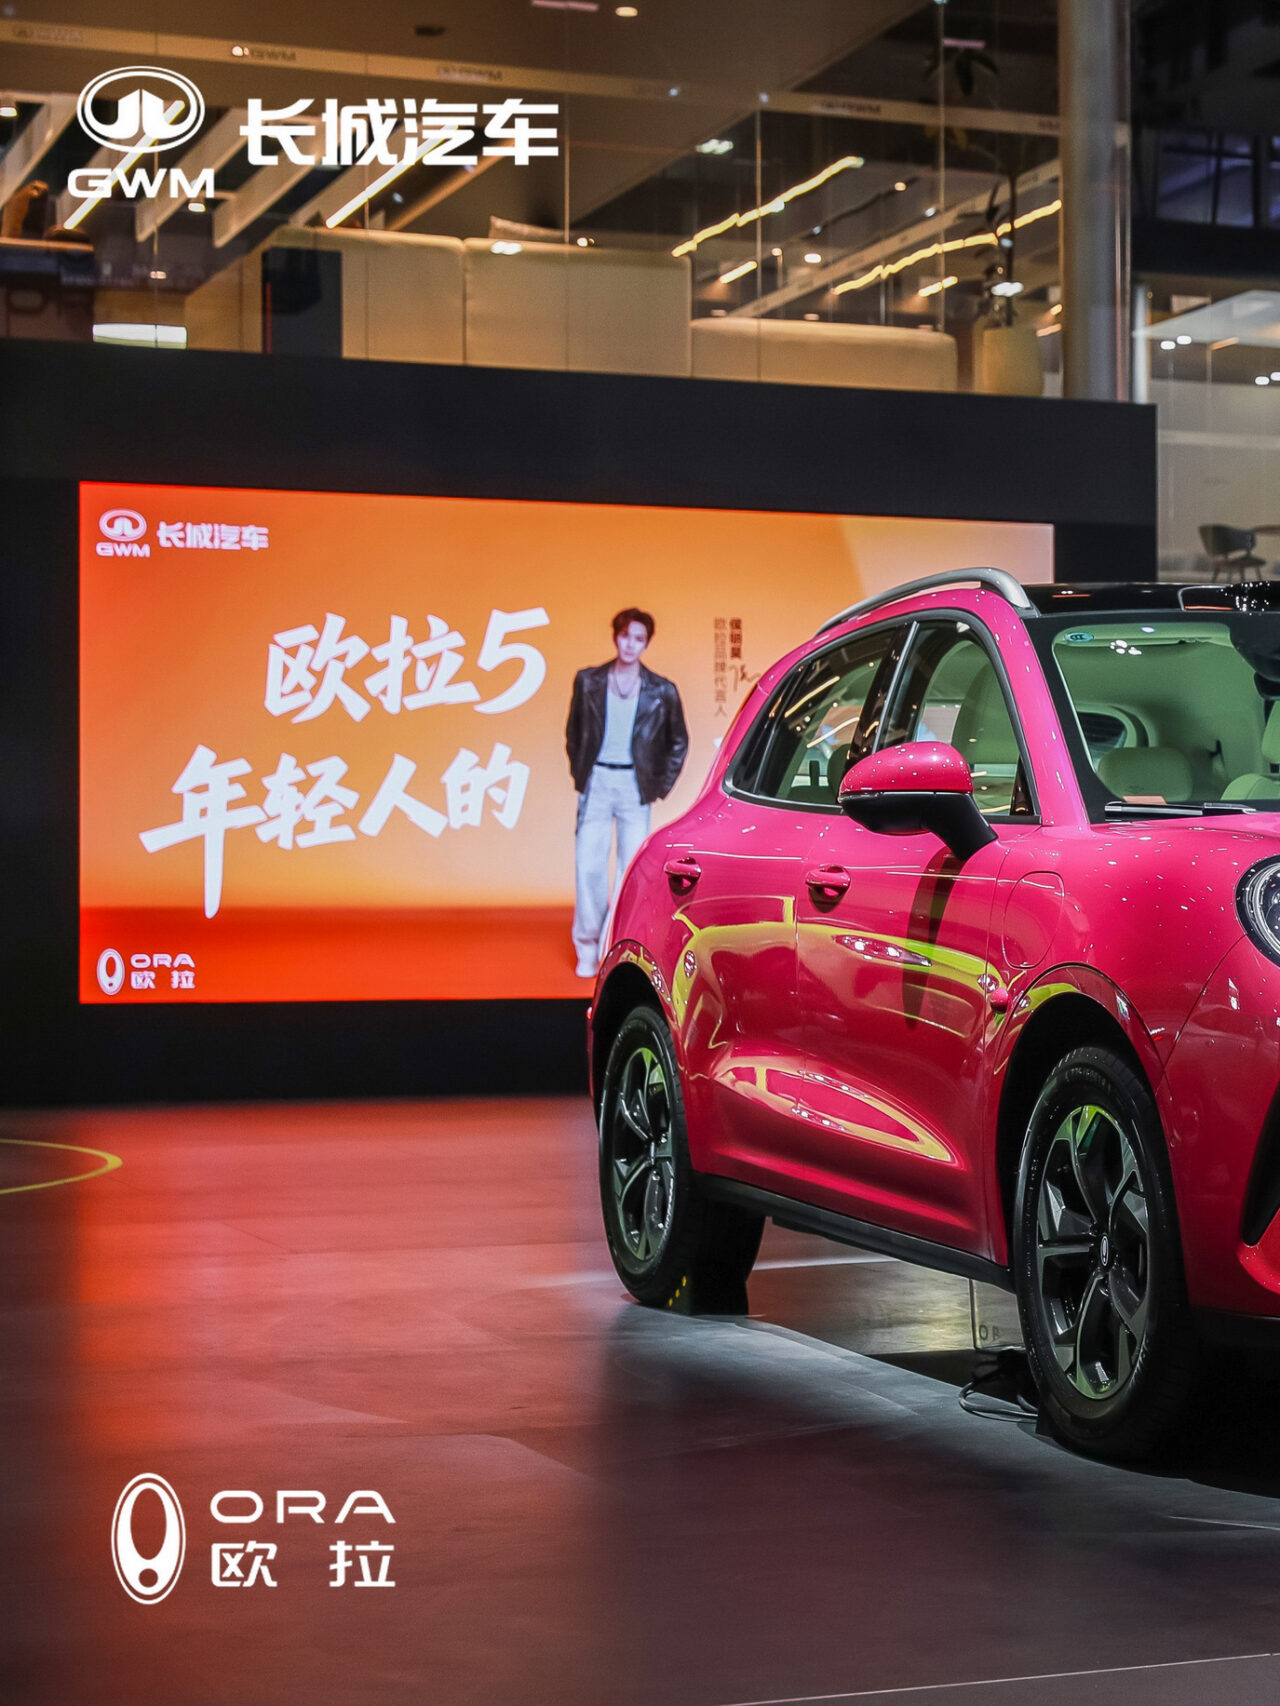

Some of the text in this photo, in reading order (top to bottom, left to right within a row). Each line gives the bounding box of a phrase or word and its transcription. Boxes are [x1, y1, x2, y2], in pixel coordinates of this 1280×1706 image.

[156, 521, 270, 551] 长城汽车
[95, 542, 151, 558] GWM
[263, 607, 550, 724] 欧拉5
[139, 742, 531, 919] 年轻人的
[130, 953, 196, 969] ORA
[130, 970, 196, 990] 欧拉
